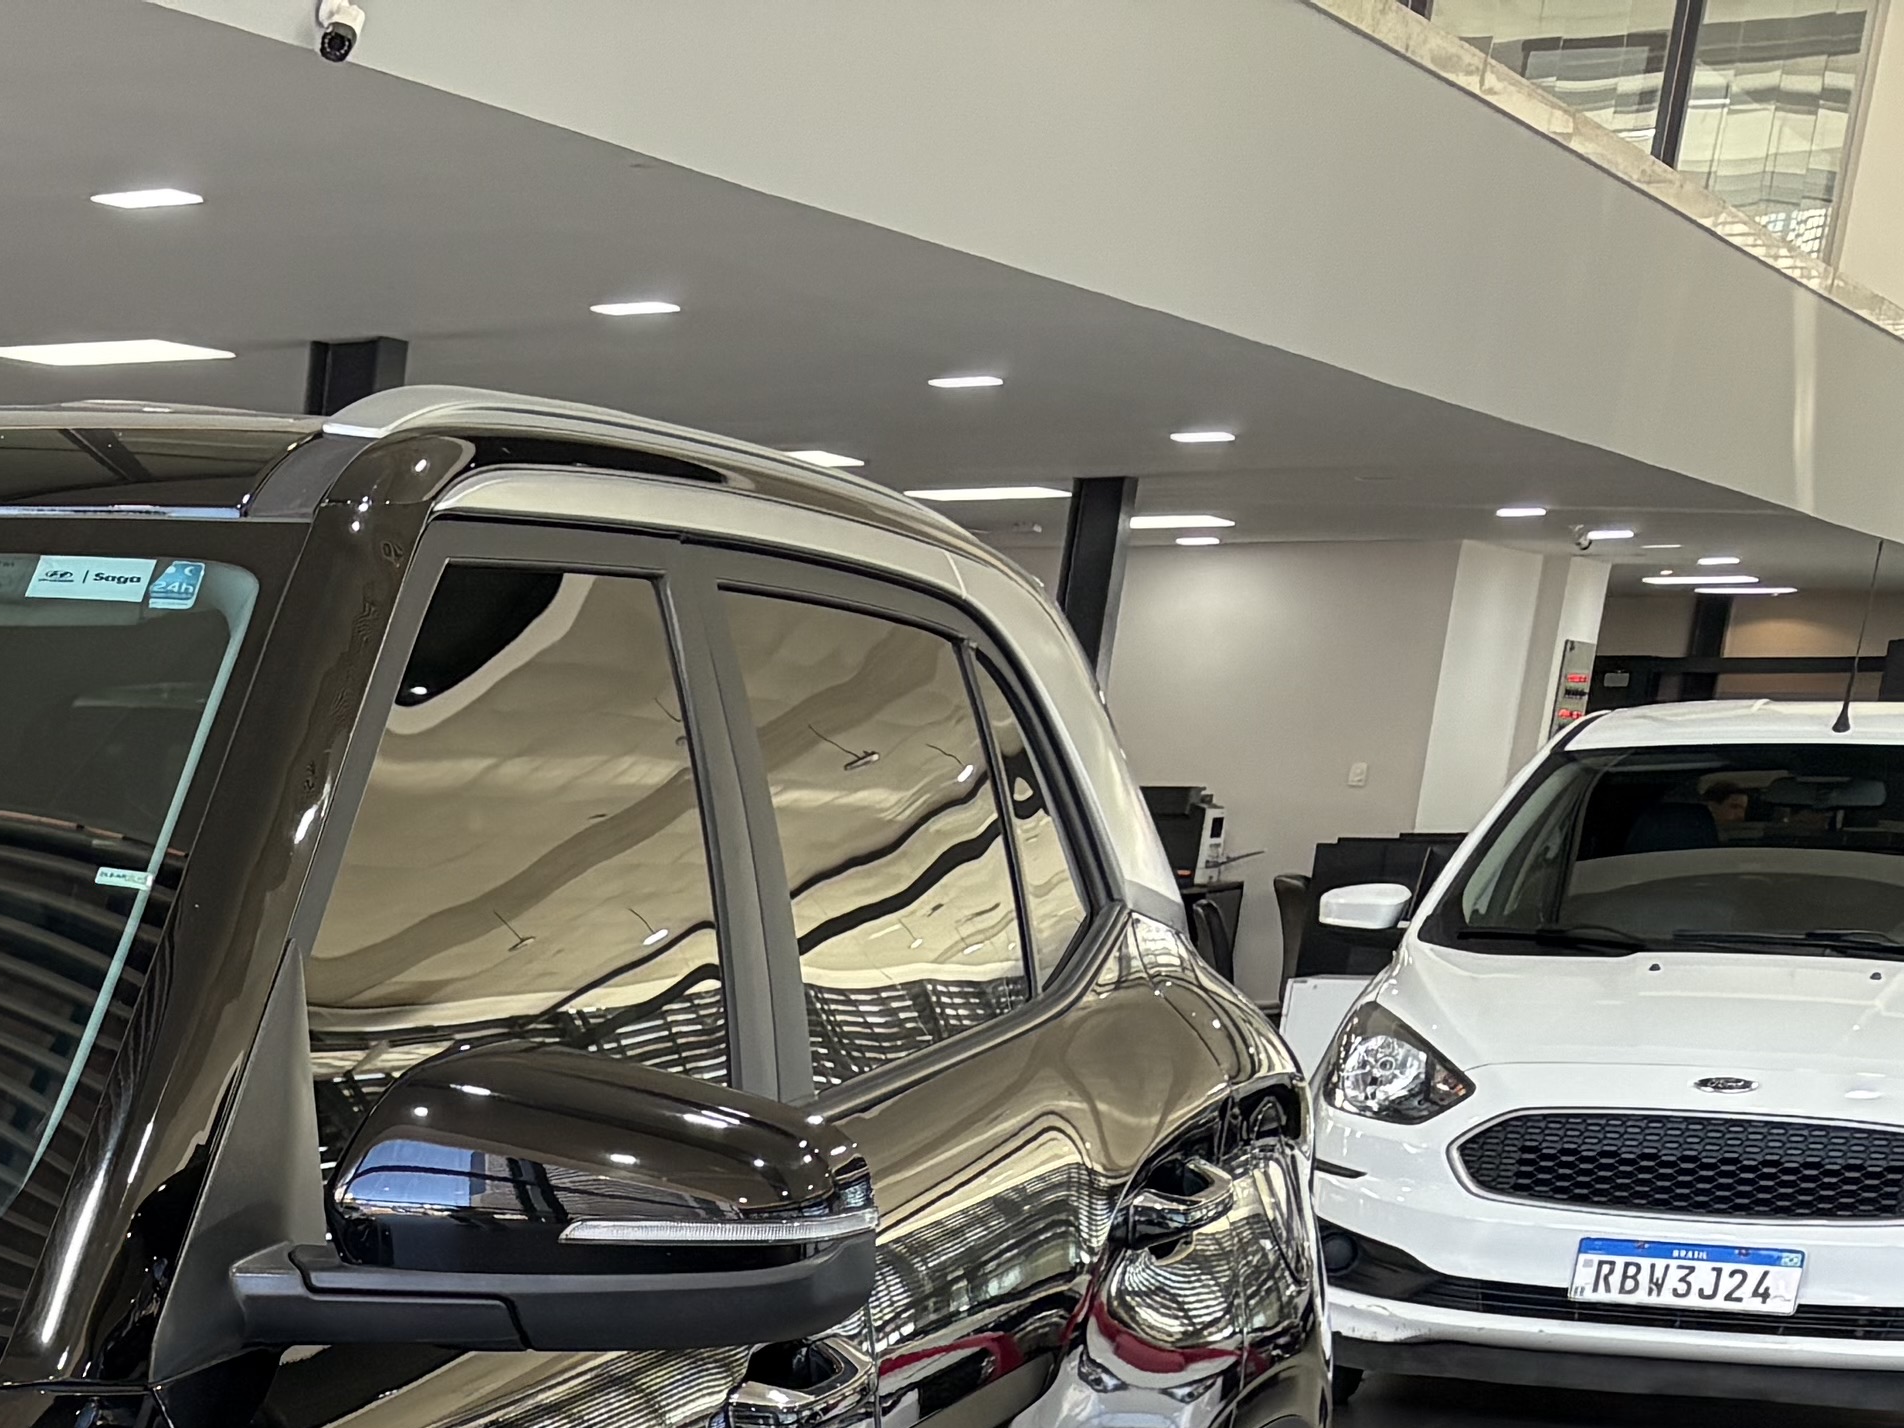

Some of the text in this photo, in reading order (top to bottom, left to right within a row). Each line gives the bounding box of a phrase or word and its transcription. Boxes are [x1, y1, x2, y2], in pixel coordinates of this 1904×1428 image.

[93, 572, 142, 584] Saga
[152, 580, 194, 593] 24h
[1592, 1259, 1772, 1304] RBW3J24
